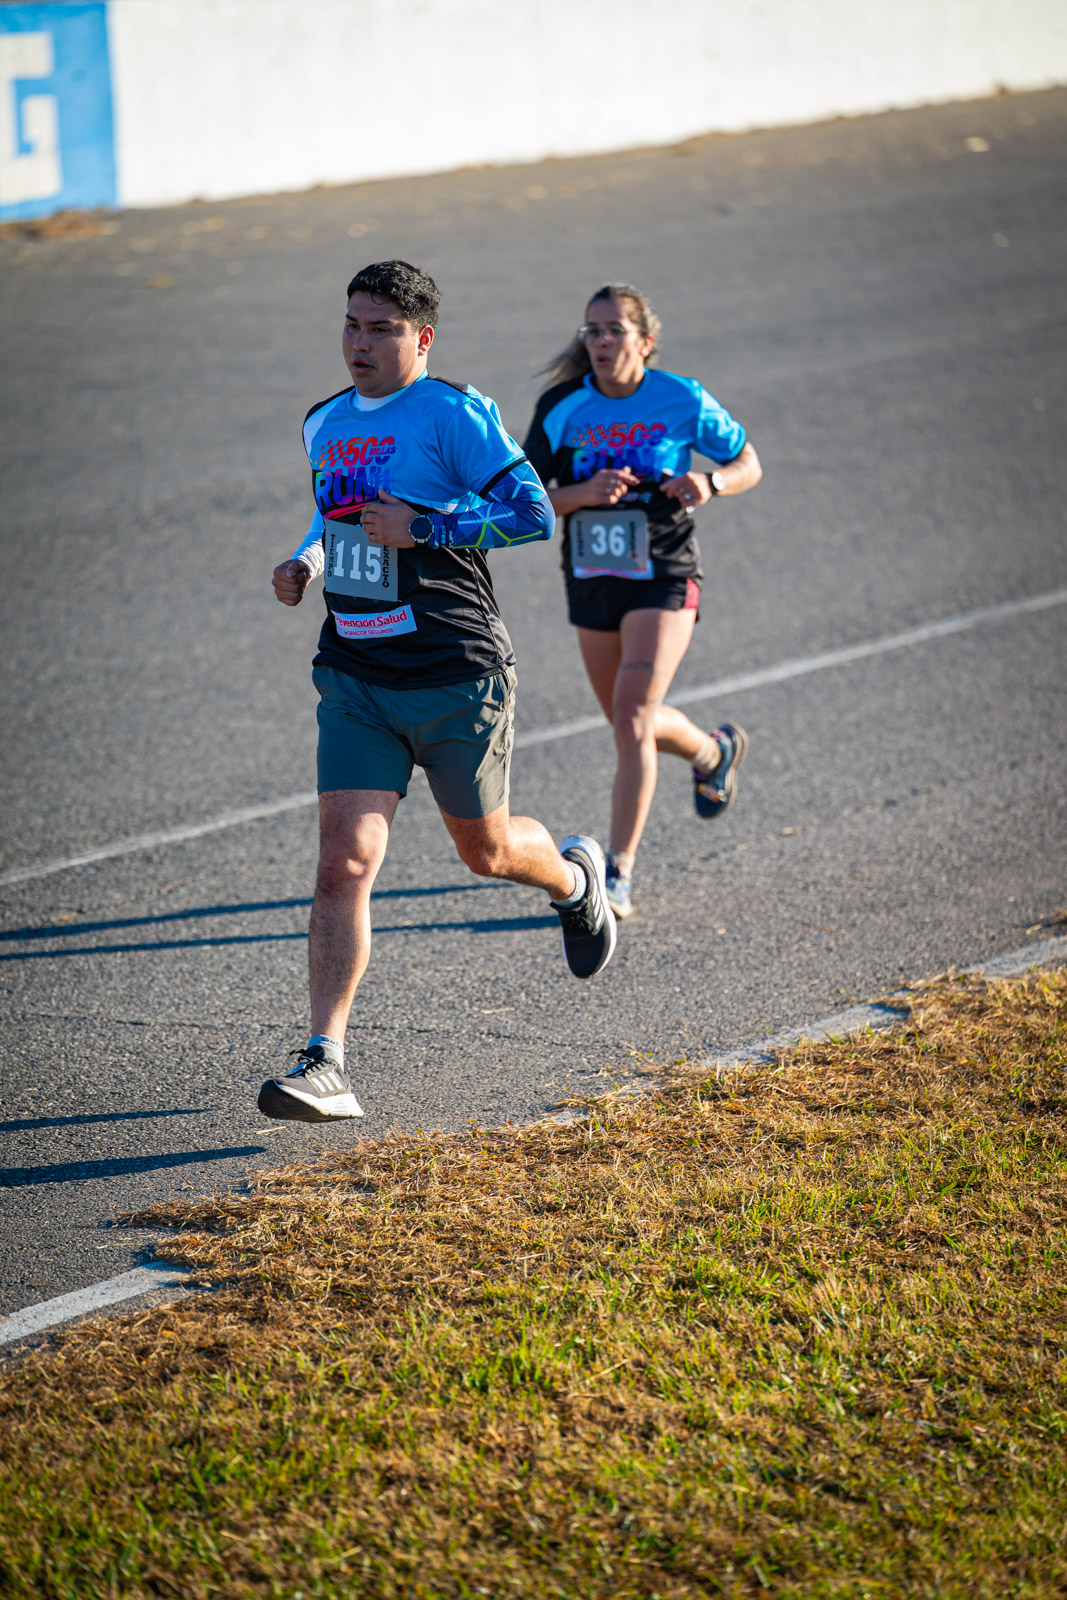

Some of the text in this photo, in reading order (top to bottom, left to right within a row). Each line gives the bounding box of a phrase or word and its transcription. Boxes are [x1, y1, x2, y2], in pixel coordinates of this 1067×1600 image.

[369, 446, 397, 455] MILLAS
[327, 533, 336, 577] TIEMPO
[591, 524, 626, 557] 36
[334, 540, 381, 582] 115
[382, 545, 390, 588] EXACTO
[336, 609, 408, 628] evención Salud
